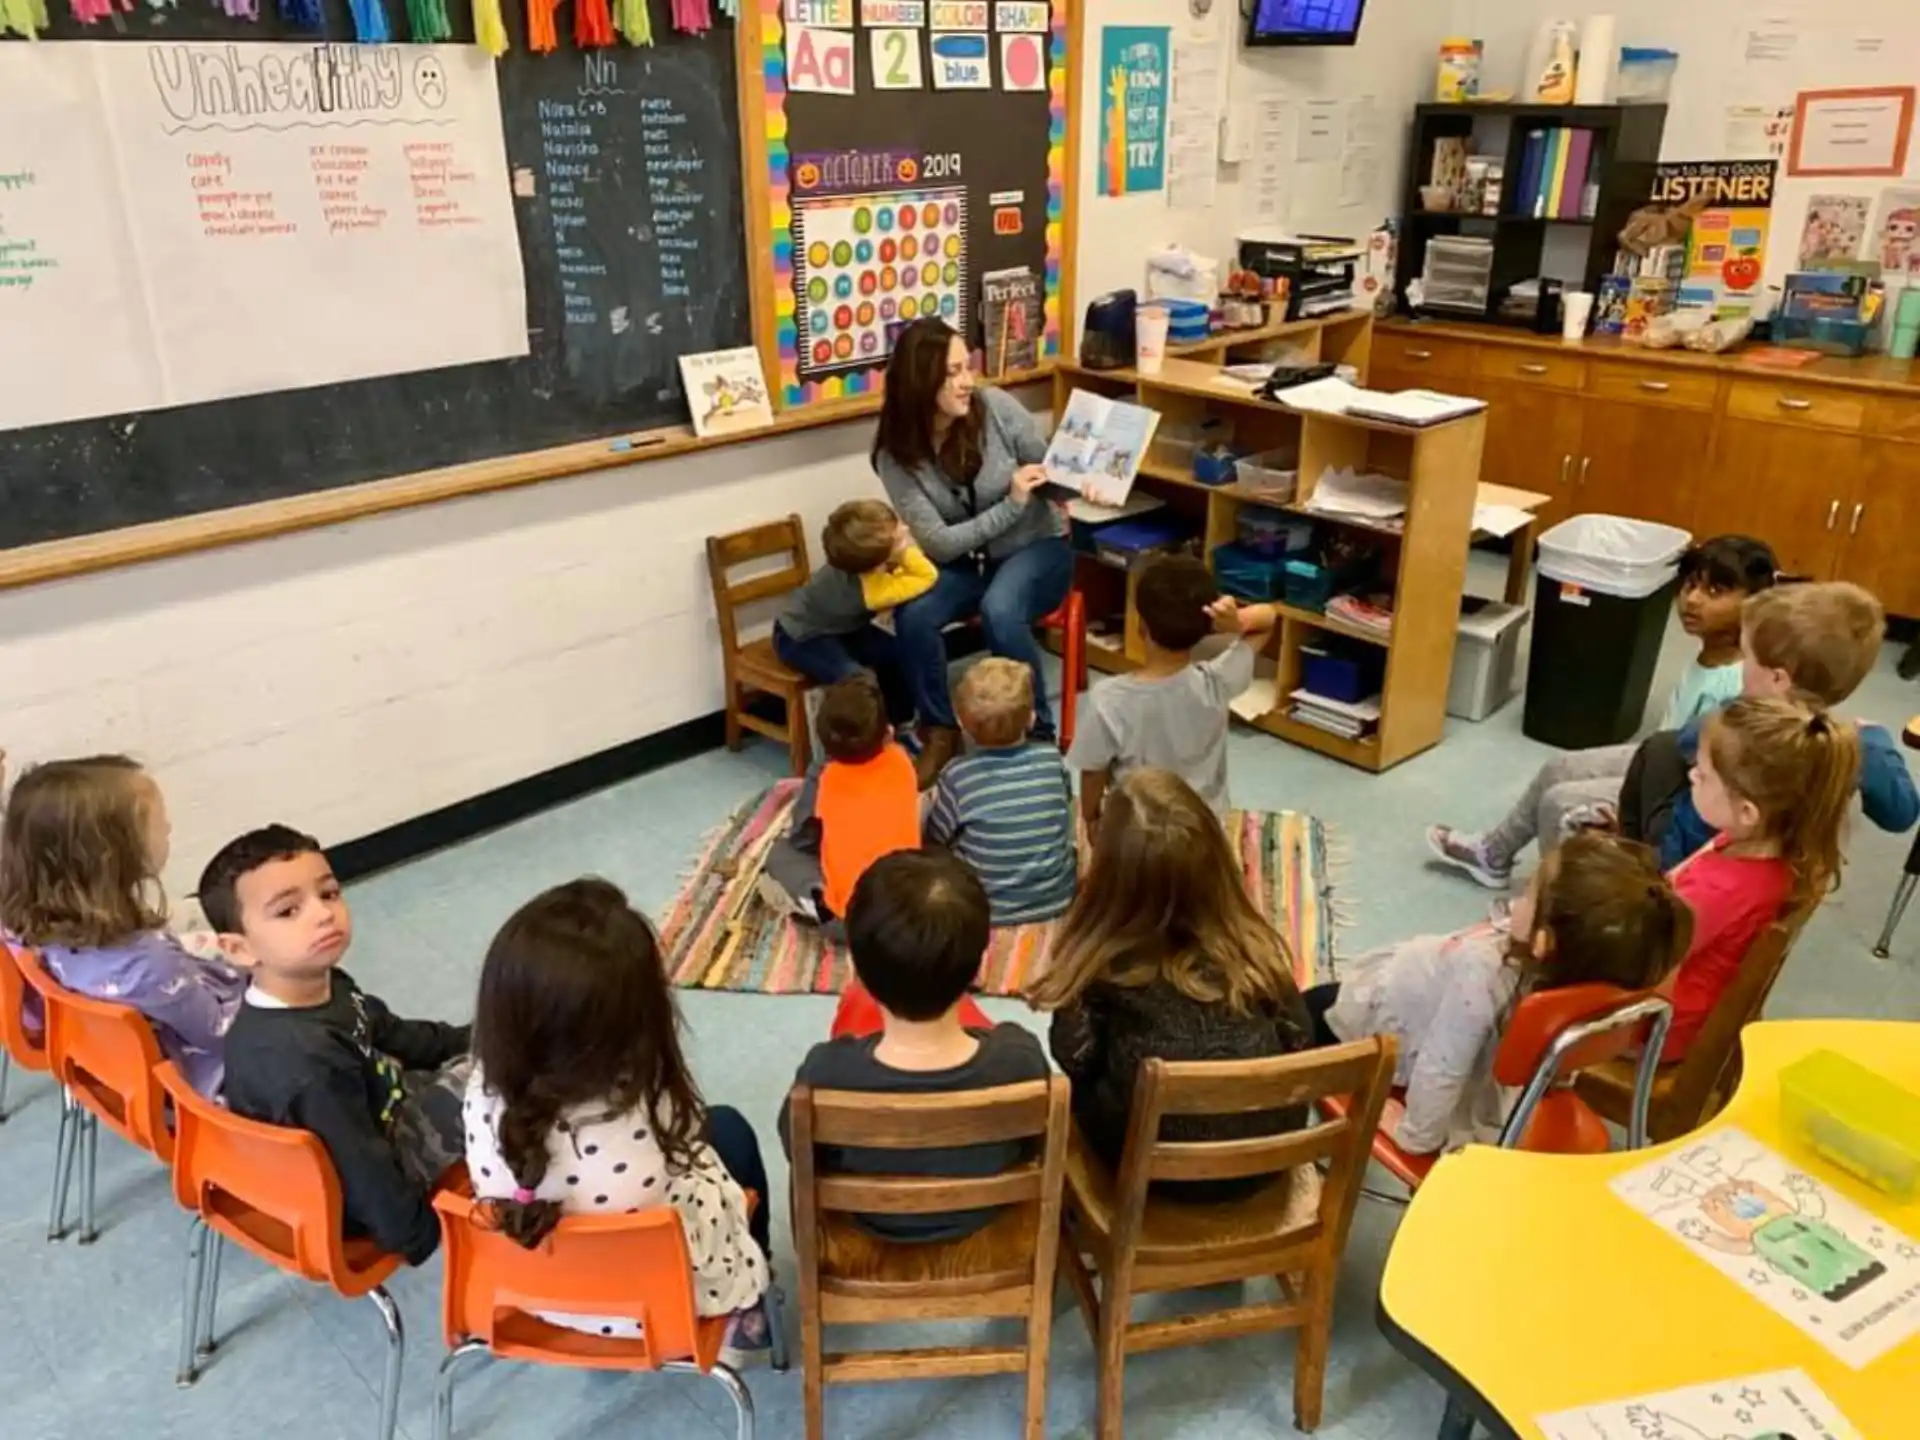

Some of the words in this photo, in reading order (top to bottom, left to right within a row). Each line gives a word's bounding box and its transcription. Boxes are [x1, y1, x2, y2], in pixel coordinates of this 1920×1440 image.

[862, 3, 922, 22] NUMBER
[931, 4, 986, 26] COLOR
[791, 30, 851, 88] Aa
[883, 31, 909, 85] 2
[944, 62, 979, 82] blue
[823, 151, 893, 186] OCTOBER
[922, 152, 962, 178] 2019
[986, 282, 1037, 302] Perfect
